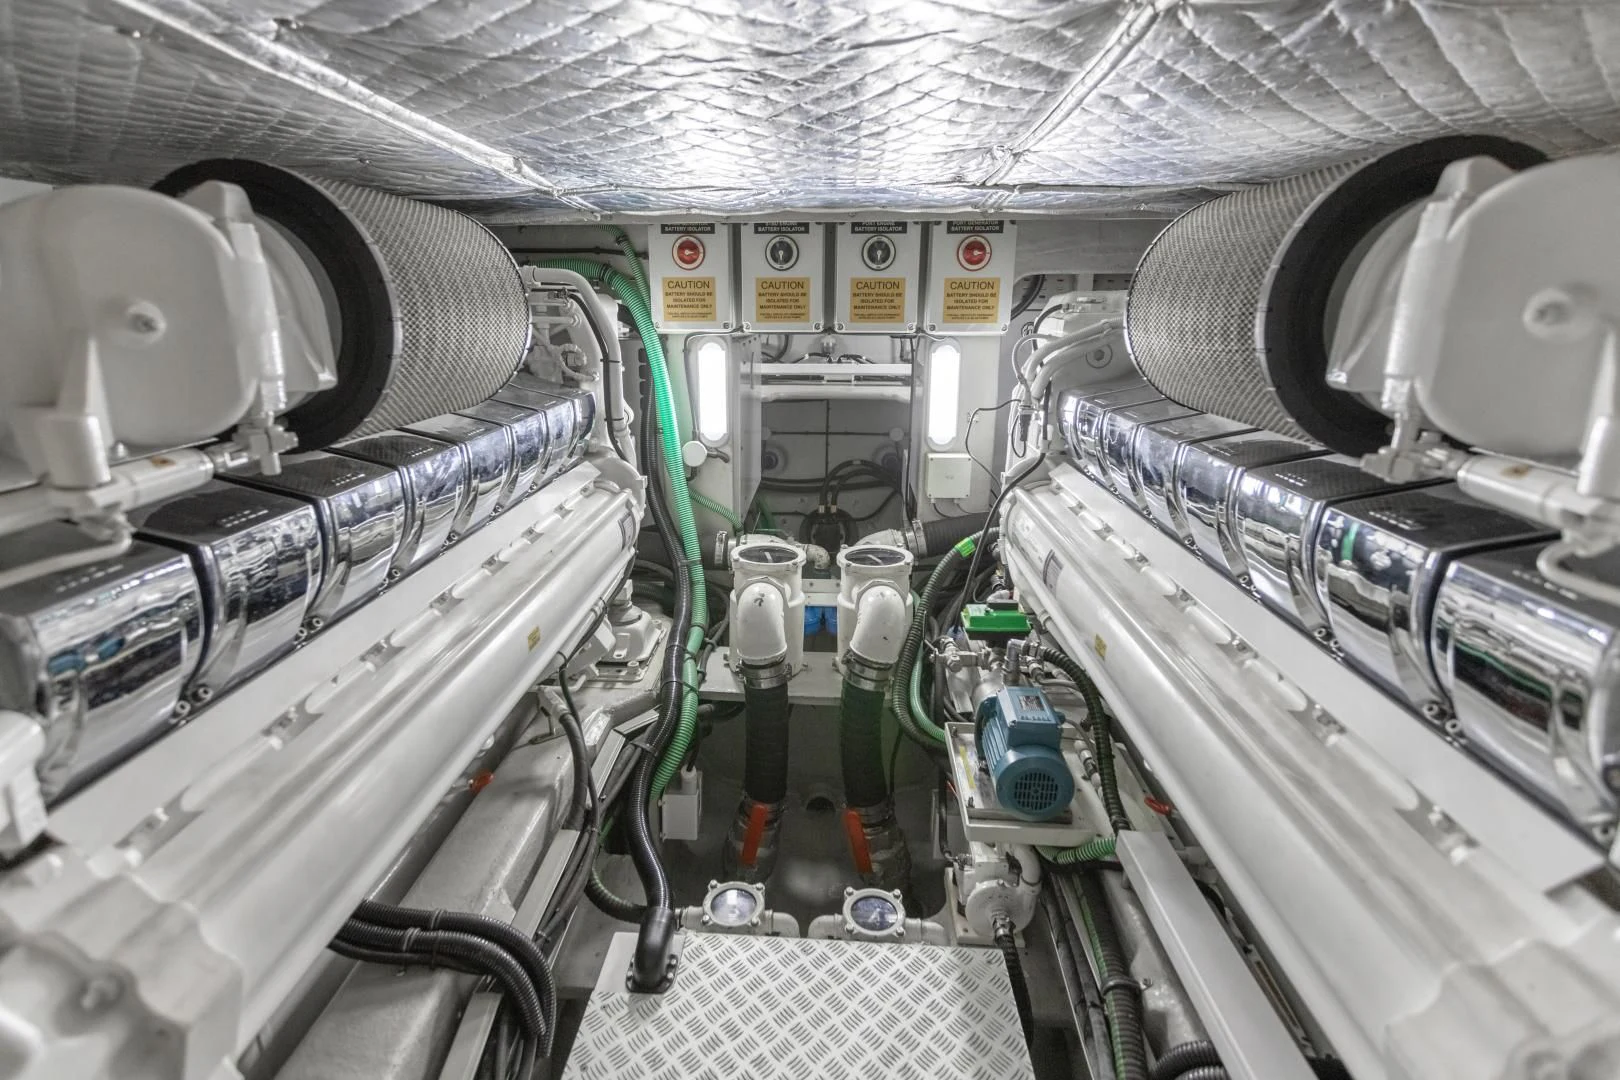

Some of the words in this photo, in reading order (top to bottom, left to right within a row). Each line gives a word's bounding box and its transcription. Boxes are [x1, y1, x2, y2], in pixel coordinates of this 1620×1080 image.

[761, 281, 804, 289] CAUTION
[856, 281, 900, 290] CAUTION
[950, 282, 994, 290] CAUTION
